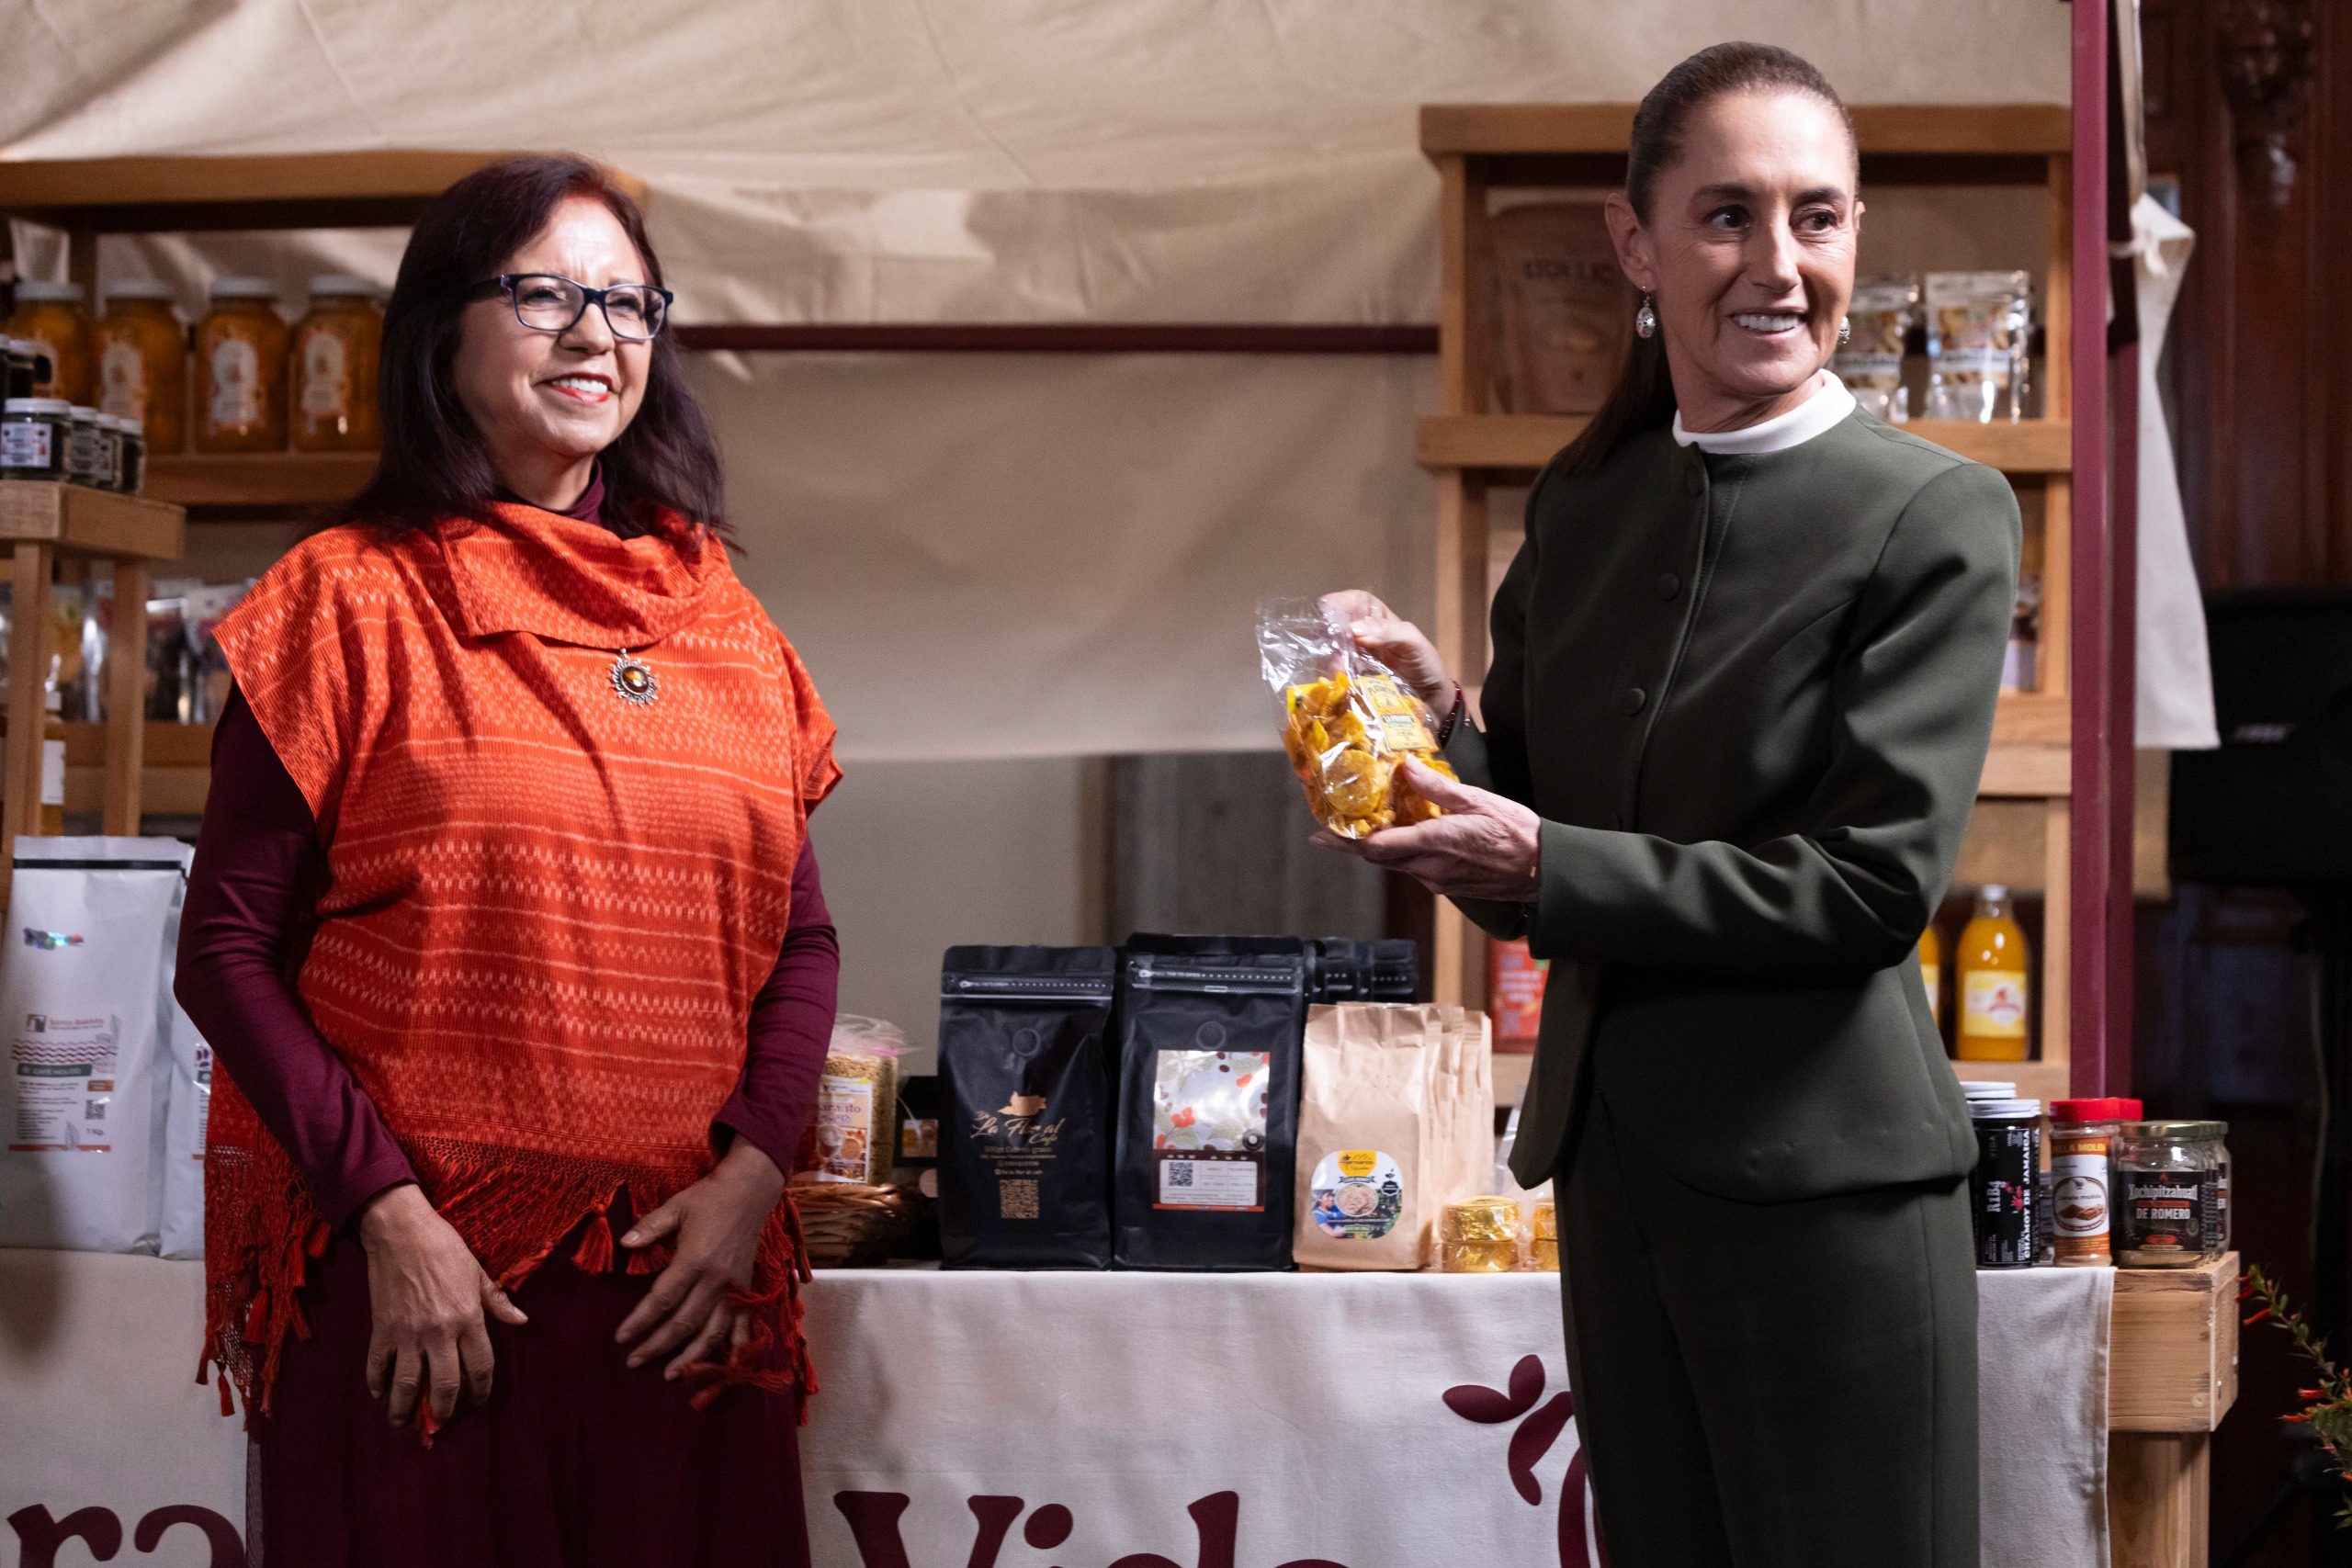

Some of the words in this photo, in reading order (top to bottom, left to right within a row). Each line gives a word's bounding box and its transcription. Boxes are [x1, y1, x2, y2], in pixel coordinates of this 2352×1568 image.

[970, 1117, 999, 1139] La
[2022, 1130, 2030, 1185] JAMAICA
[2023, 1189, 2030, 1206] DE
[2136, 1208, 2149, 1220] DE
[2151, 1208, 2191, 1220] ROMERO
[2022, 1208, 2031, 1259] CHAMOY
